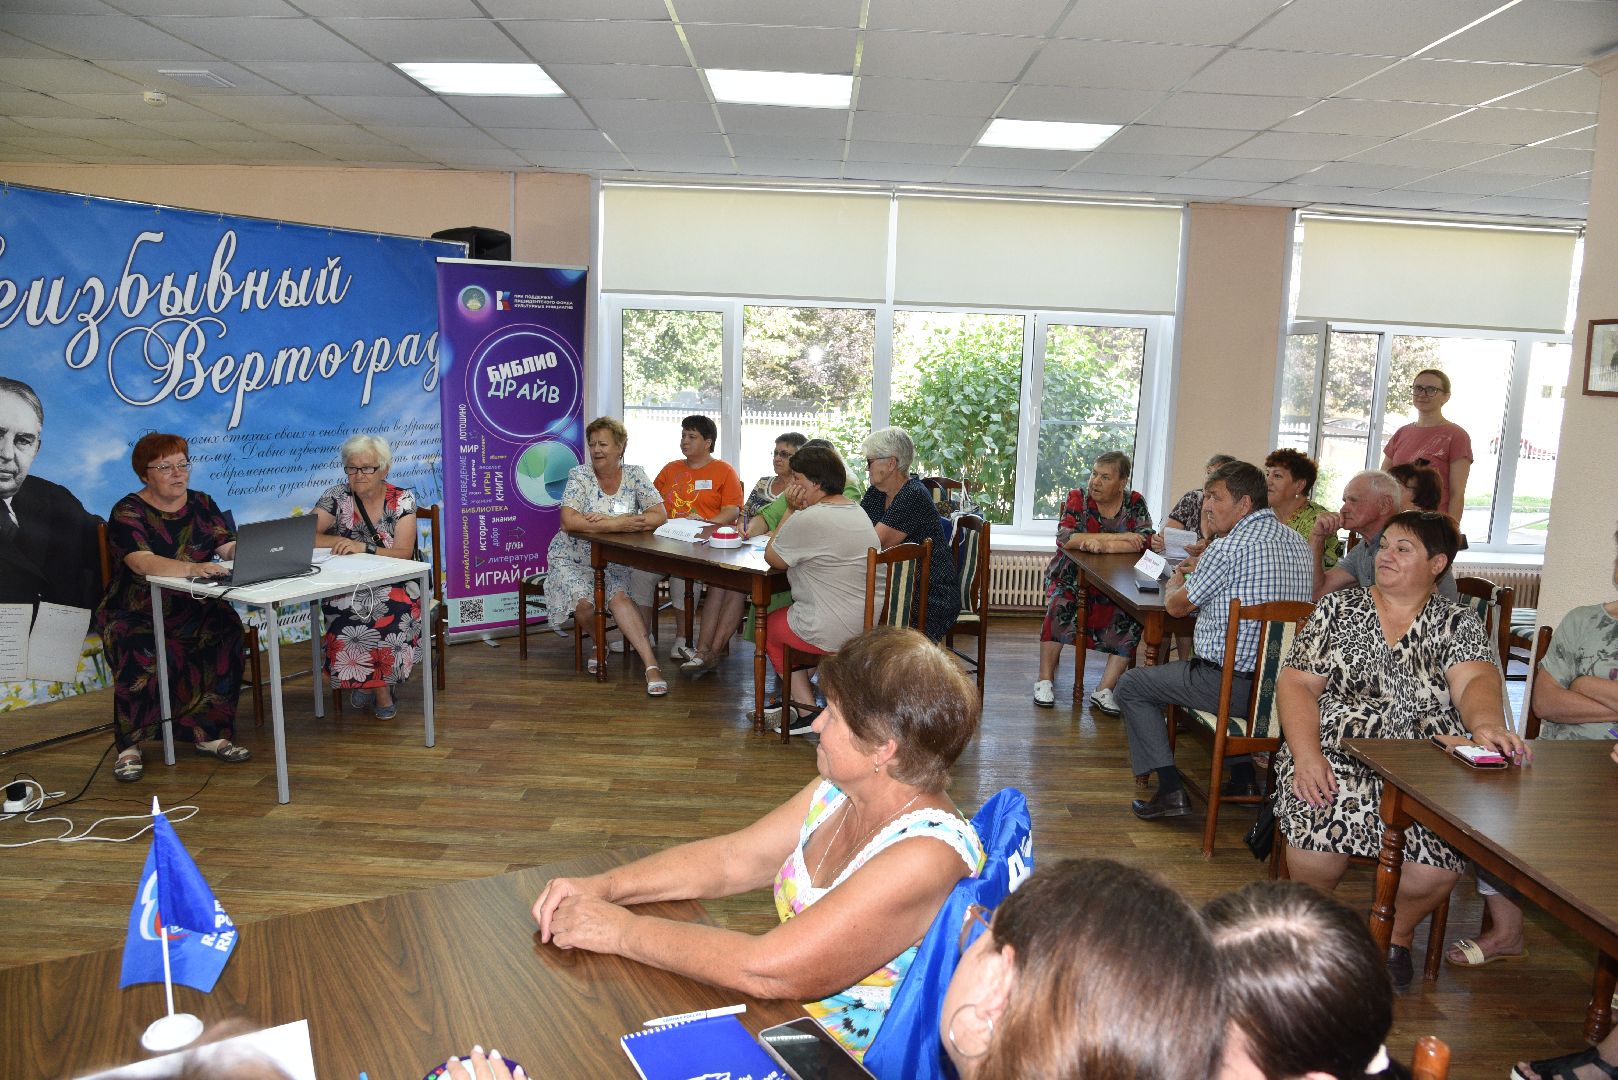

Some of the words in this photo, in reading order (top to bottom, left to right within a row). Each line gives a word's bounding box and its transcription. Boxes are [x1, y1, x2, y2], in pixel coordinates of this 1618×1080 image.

[0, 230, 352, 370] еизбывный
[487, 351, 558, 382] БИБЛИО
[488, 379, 560, 404] ДРАЙВ
[459, 403, 467, 441] ЛОТОШИНО
[460, 445, 479, 454] МИР
[459, 455, 469, 506] КРАЕВЕДЕНИЕ
[484, 471, 492, 496] ИГРЫ
[496, 471, 504, 502] КНИГИ
[461, 505, 509, 514] БИБЛИОТЕКА
[491, 515, 517, 524] знания
[479, 515, 489, 551] ИСТОРИЯ
[490, 527, 501, 547] добро
[461, 516, 471, 590] #ЧИТАЙЛОТОШИНО
[488, 552, 539, 565] литература
[505, 541, 524, 552] ДРУЖБА
[475, 564, 521, 588] ИГРАЙ
